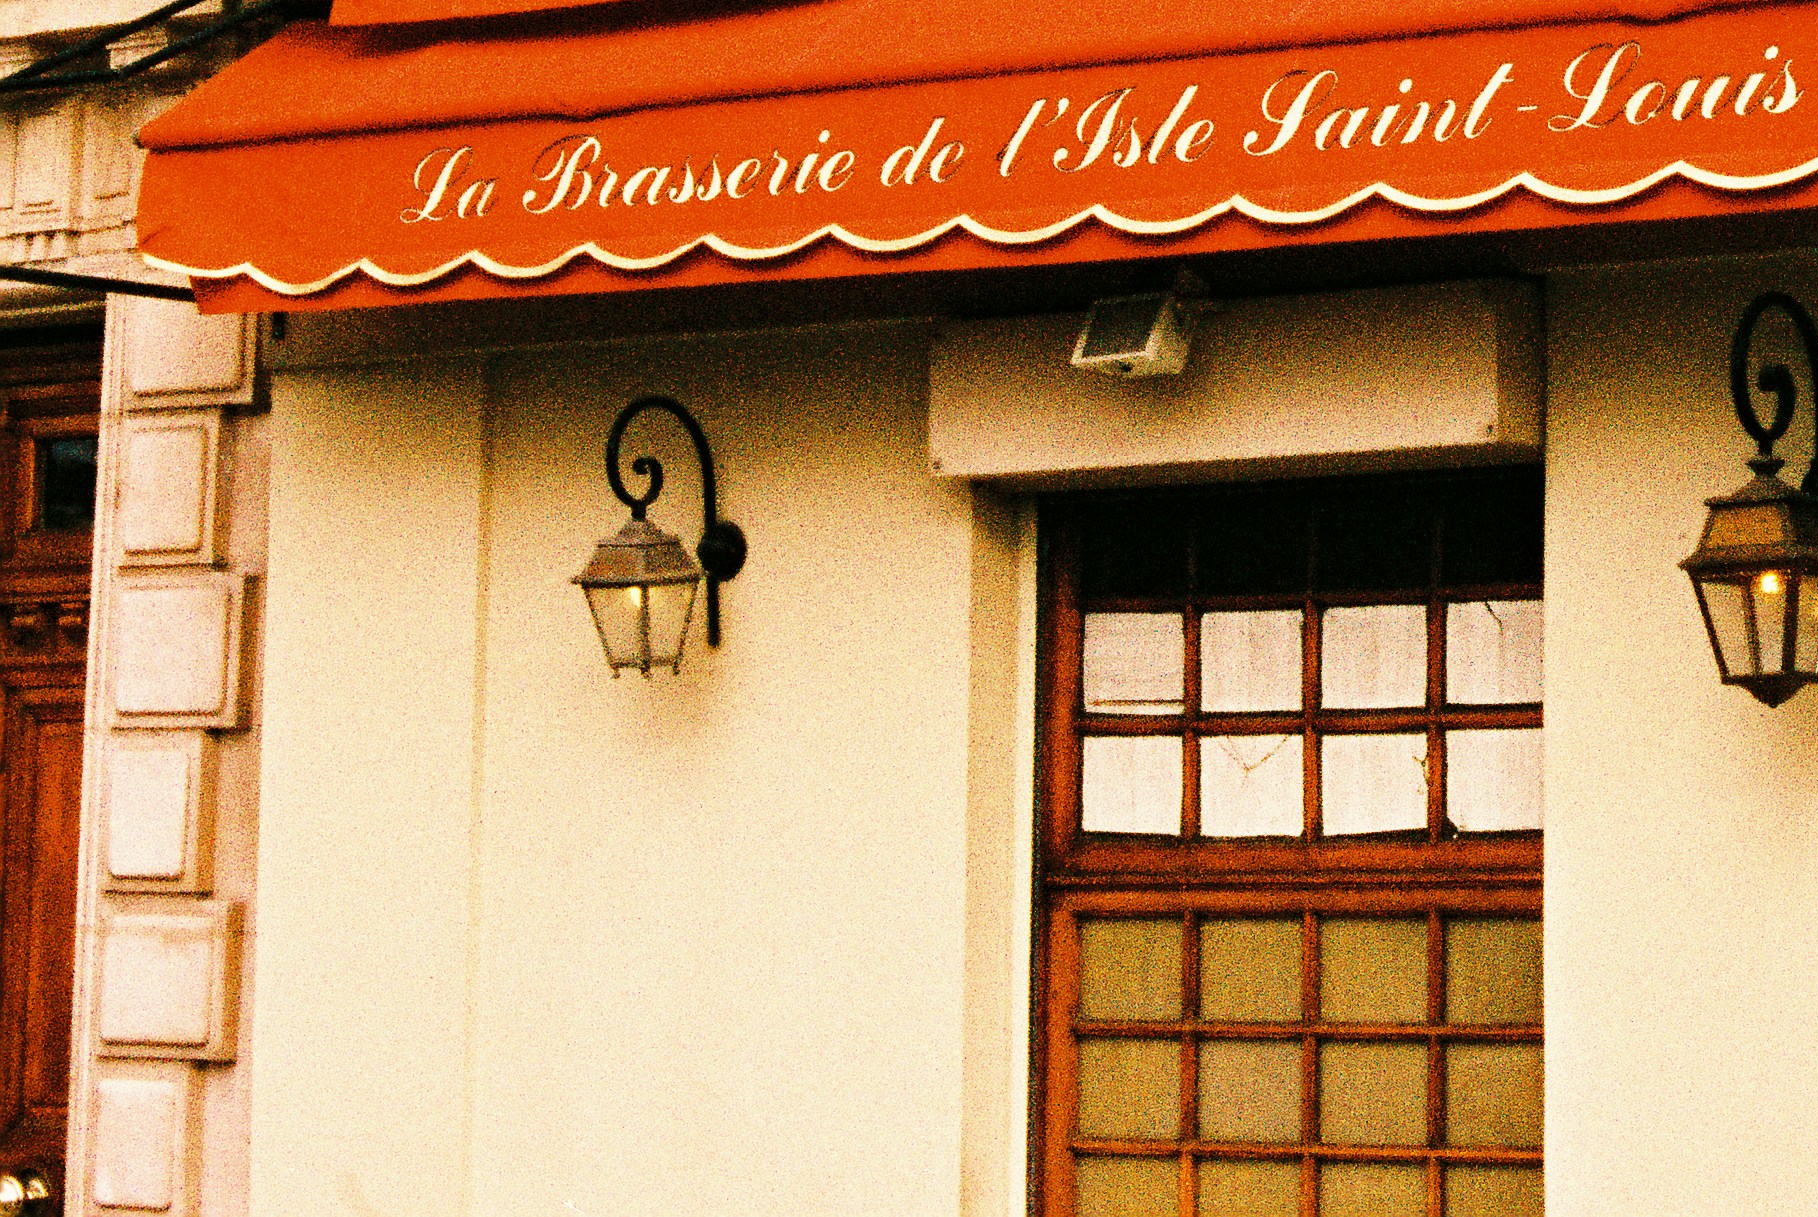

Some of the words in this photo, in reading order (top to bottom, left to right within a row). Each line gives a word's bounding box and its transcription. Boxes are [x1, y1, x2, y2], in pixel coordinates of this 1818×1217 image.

[400, 145, 499, 224] La
[522, 129, 855, 214] Brasserie
[881, 117, 966, 186] de
[996, 84, 1214, 177] l'Isle
